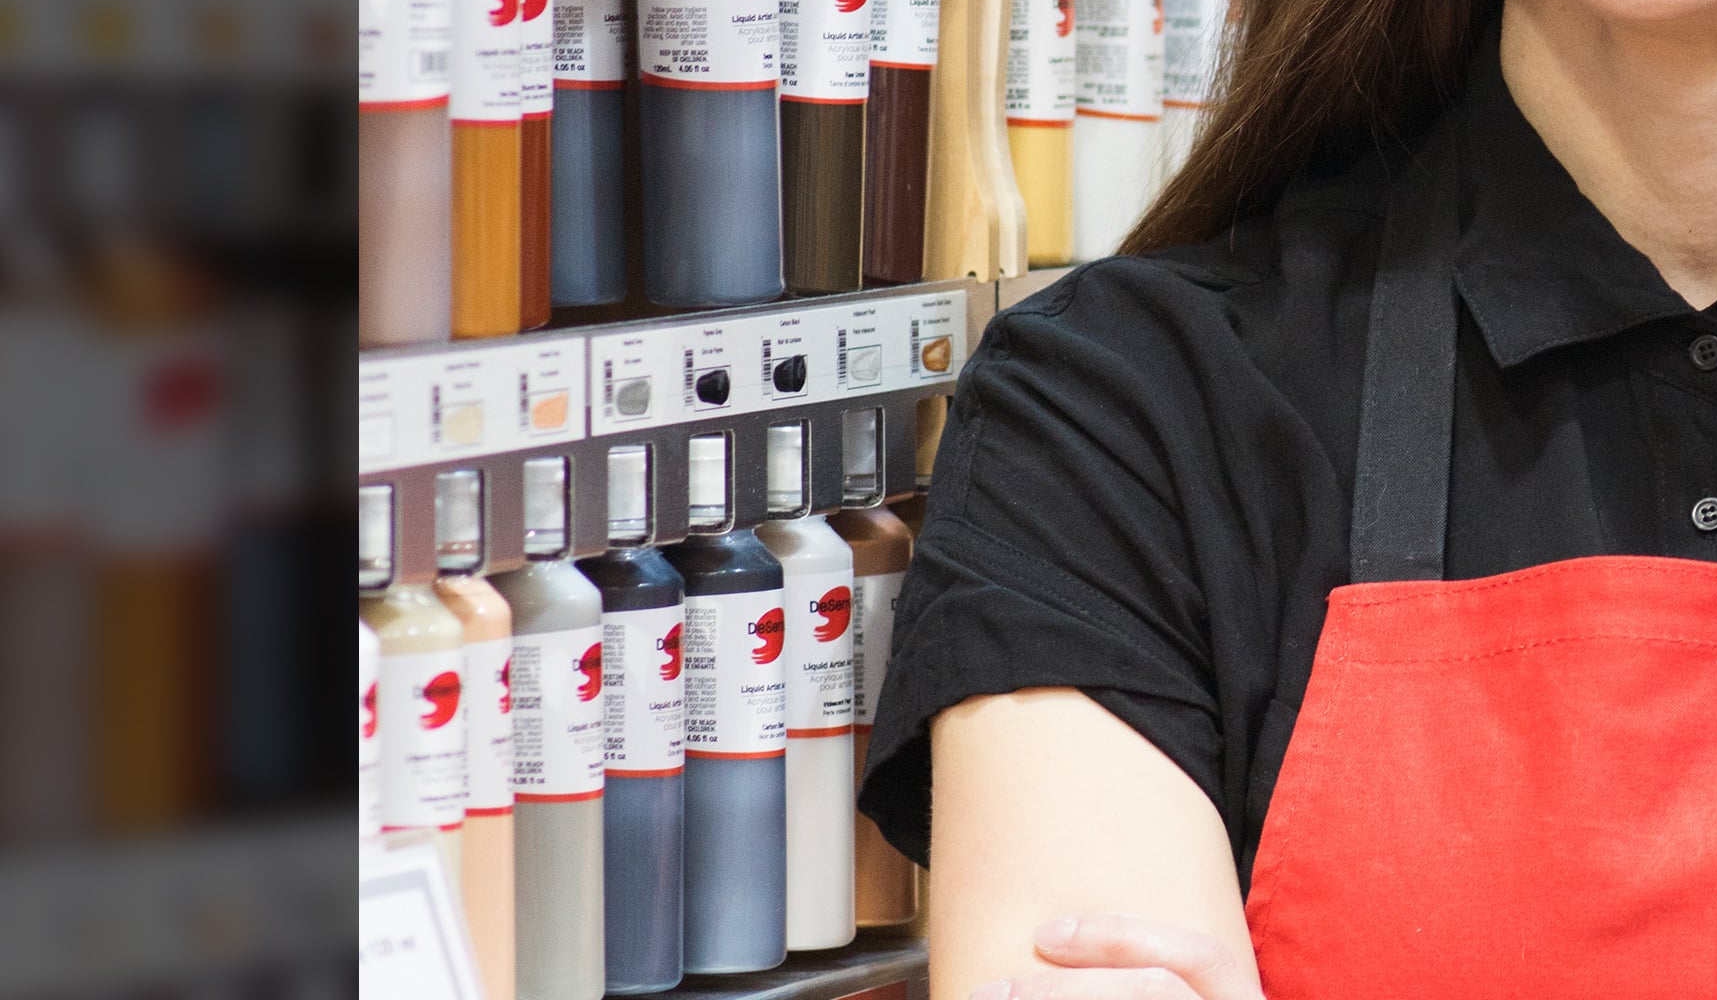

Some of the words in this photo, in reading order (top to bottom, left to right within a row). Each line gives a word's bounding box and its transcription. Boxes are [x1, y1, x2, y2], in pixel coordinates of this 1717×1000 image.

[731, 14, 757, 24] Liquid
[822, 32, 847, 42] Liquid
[803, 661, 829, 672] Liquid
[740, 684, 765, 694] Liquid
[649, 701, 671, 712] Liquid
